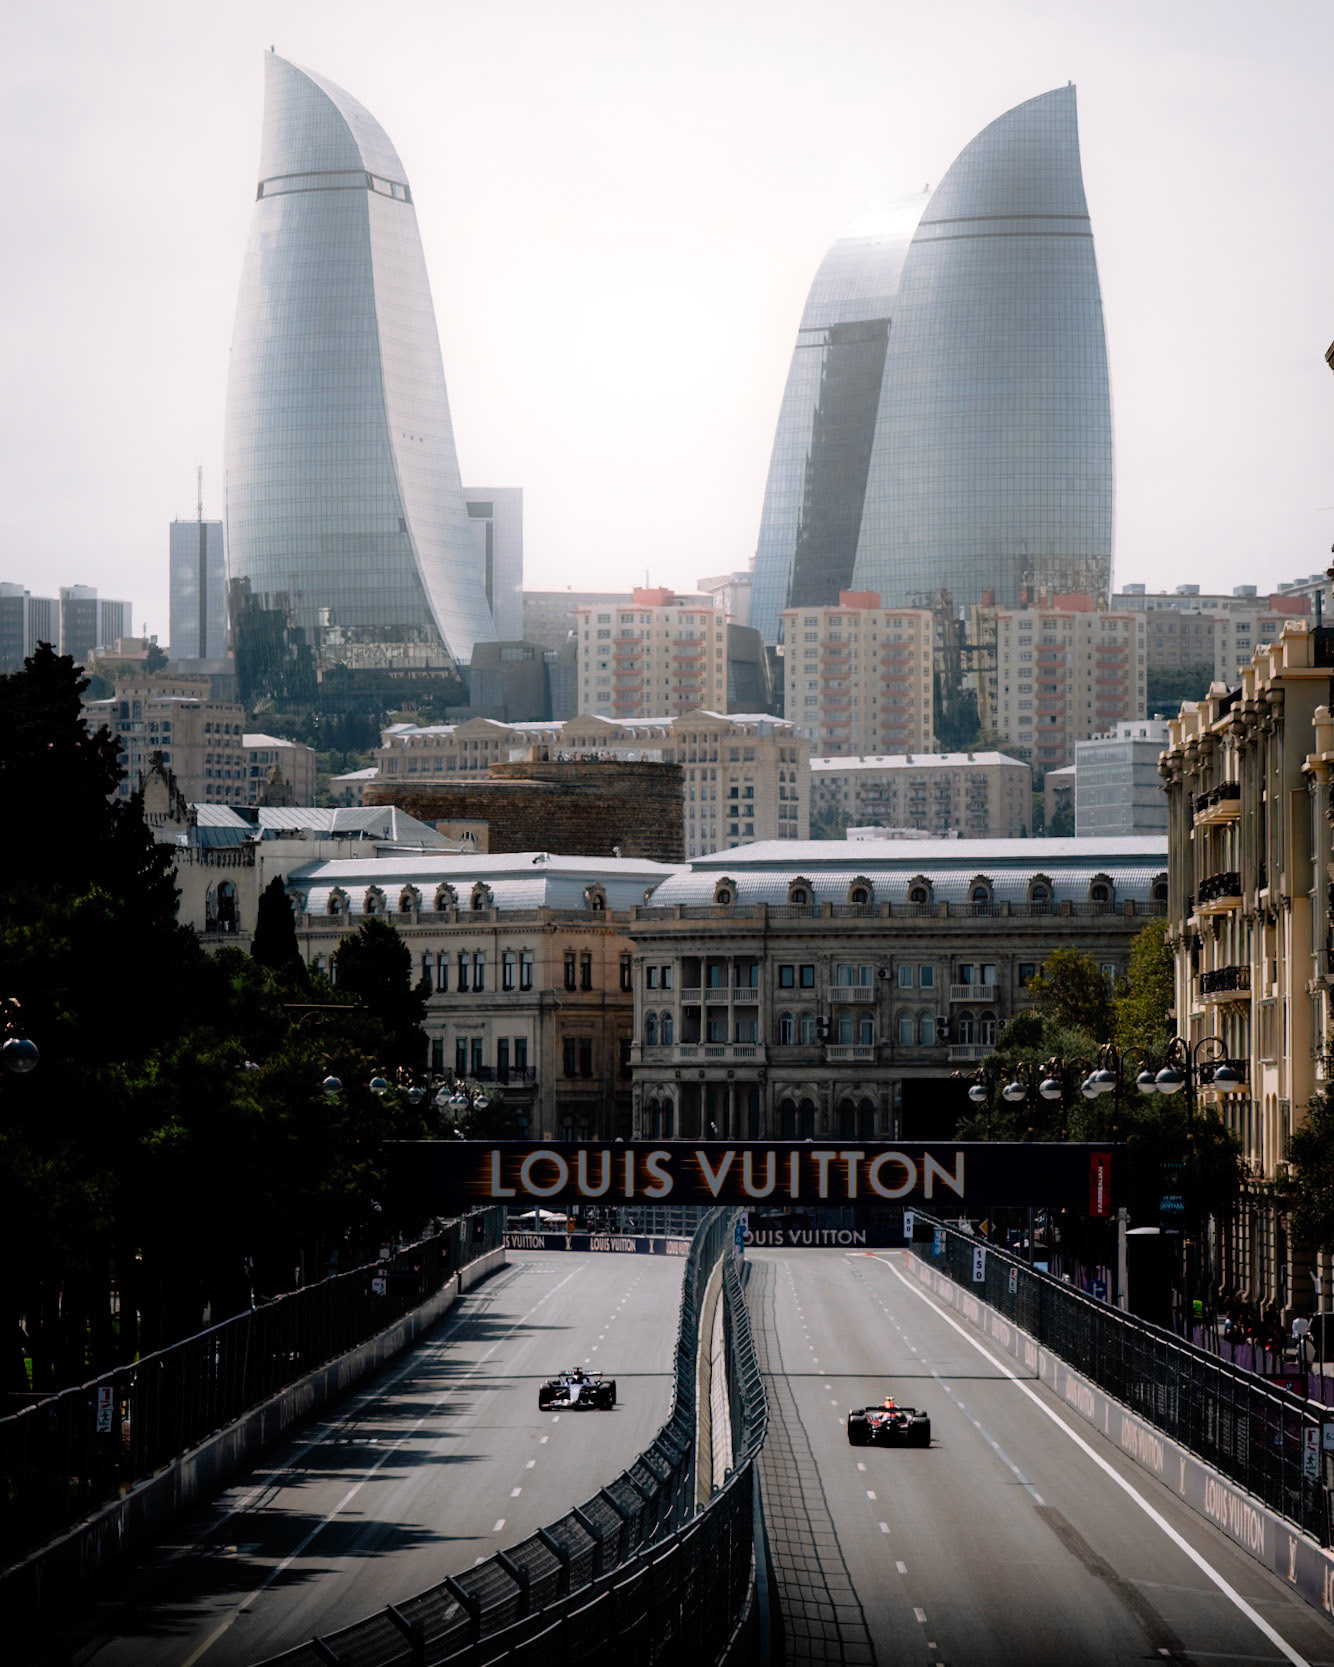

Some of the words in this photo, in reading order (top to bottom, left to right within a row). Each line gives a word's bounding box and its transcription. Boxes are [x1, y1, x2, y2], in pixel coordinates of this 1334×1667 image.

[490, 1150, 673, 1197] LOUIS
[695, 1150, 965, 1198] VUITTON
[511, 1234, 545, 1249] VUITTON
[590, 1237, 610, 1251] LOUIS
[788, 1229, 866, 1245] VUITTON
[1204, 1475, 1228, 1527] LOUIS
[1228, 1492, 1265, 1556] VUITTON
